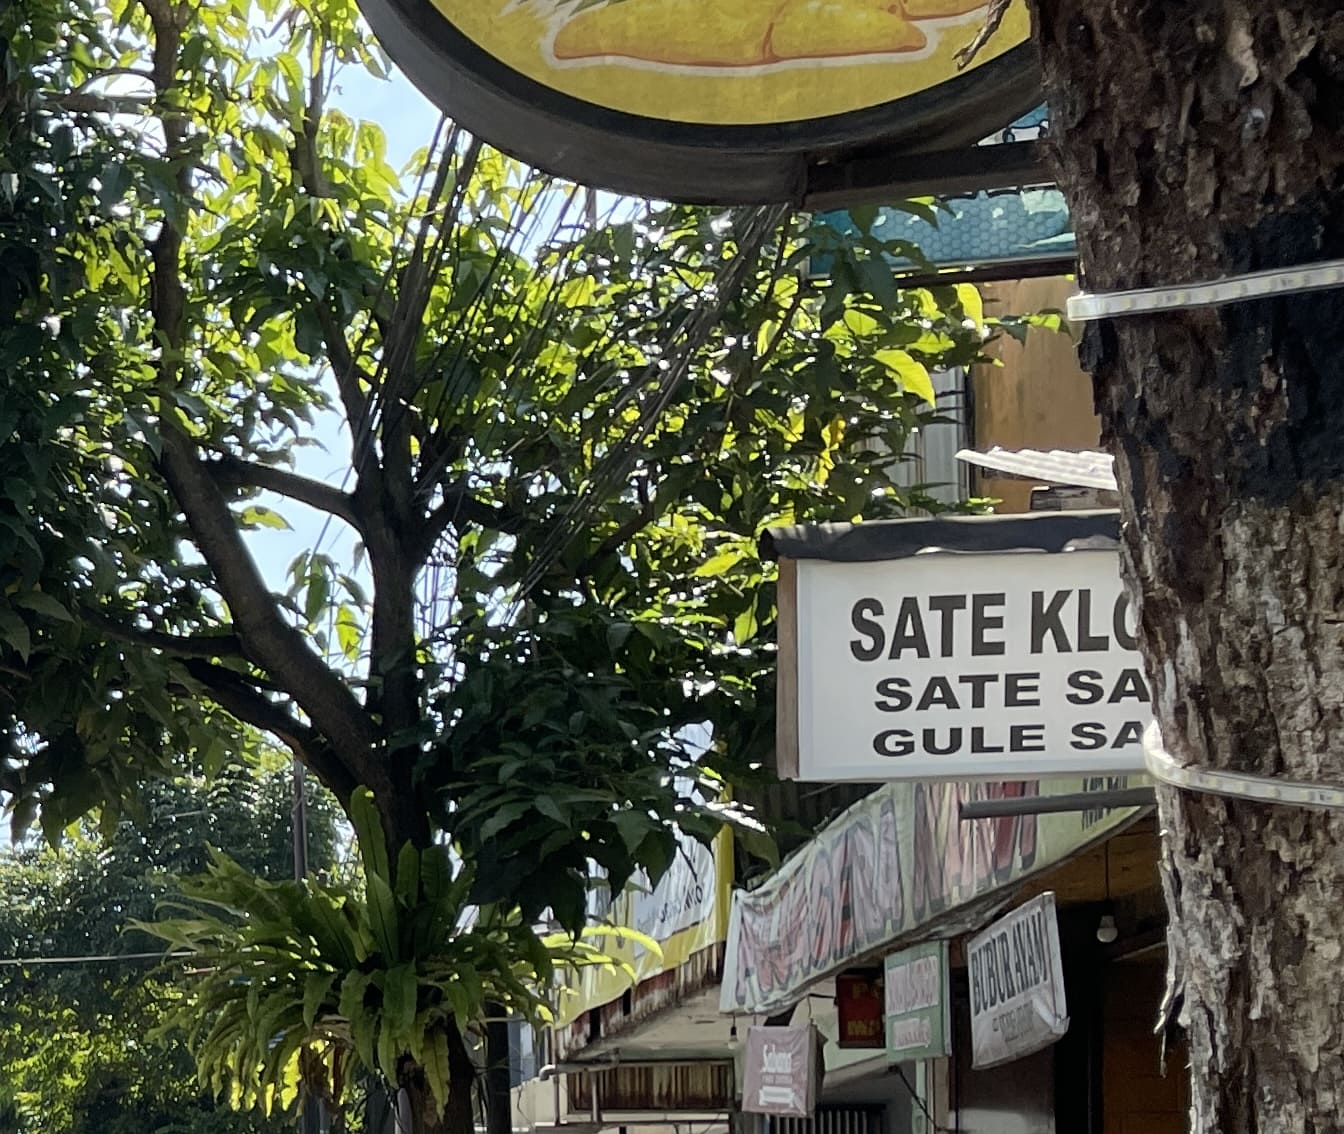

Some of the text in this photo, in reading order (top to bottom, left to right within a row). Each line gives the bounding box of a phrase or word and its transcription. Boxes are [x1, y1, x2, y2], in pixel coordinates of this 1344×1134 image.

[850, 593, 1006, 661] SATE
[874, 668, 1150, 713] SATE SA
[873, 721, 1145, 756] GULE SA
[972, 931, 1017, 1017] BUBUR
[1013, 911, 1047, 994] AYAM
